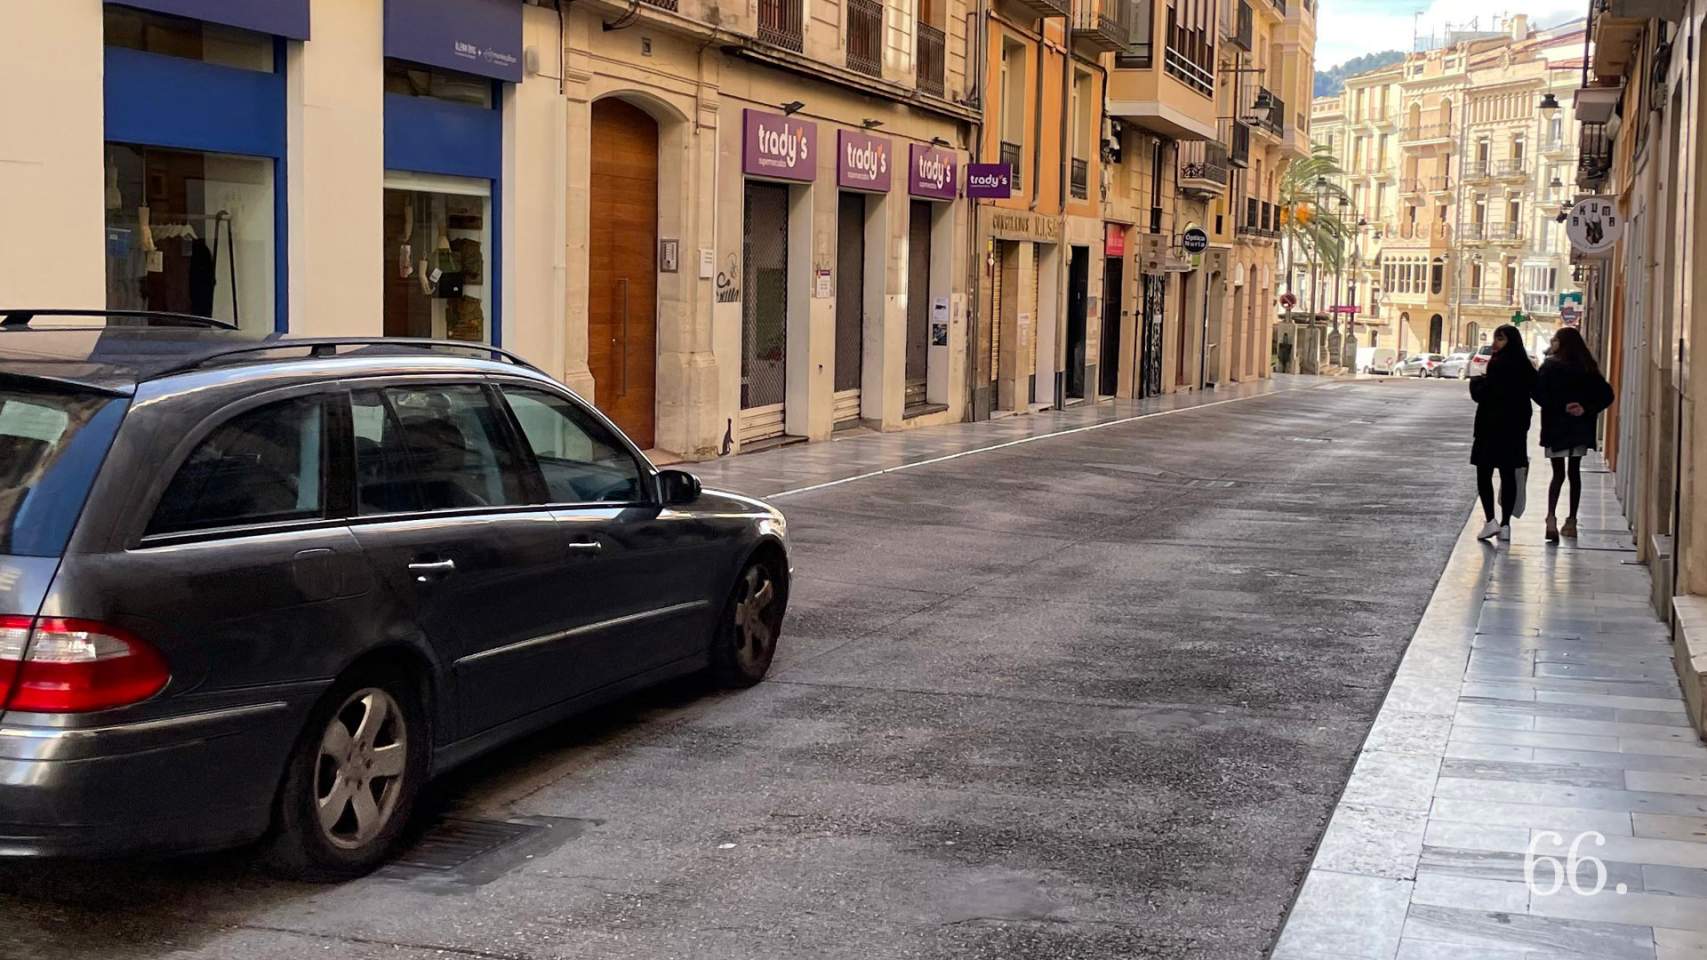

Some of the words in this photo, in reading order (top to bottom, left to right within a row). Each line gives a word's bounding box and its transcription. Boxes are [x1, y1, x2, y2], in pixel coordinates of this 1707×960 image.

[758, 123, 808, 168] trady's
[847, 141, 887, 181] trady's
[919, 154, 951, 189] trady's
[971, 174, 1008, 188] trady's
